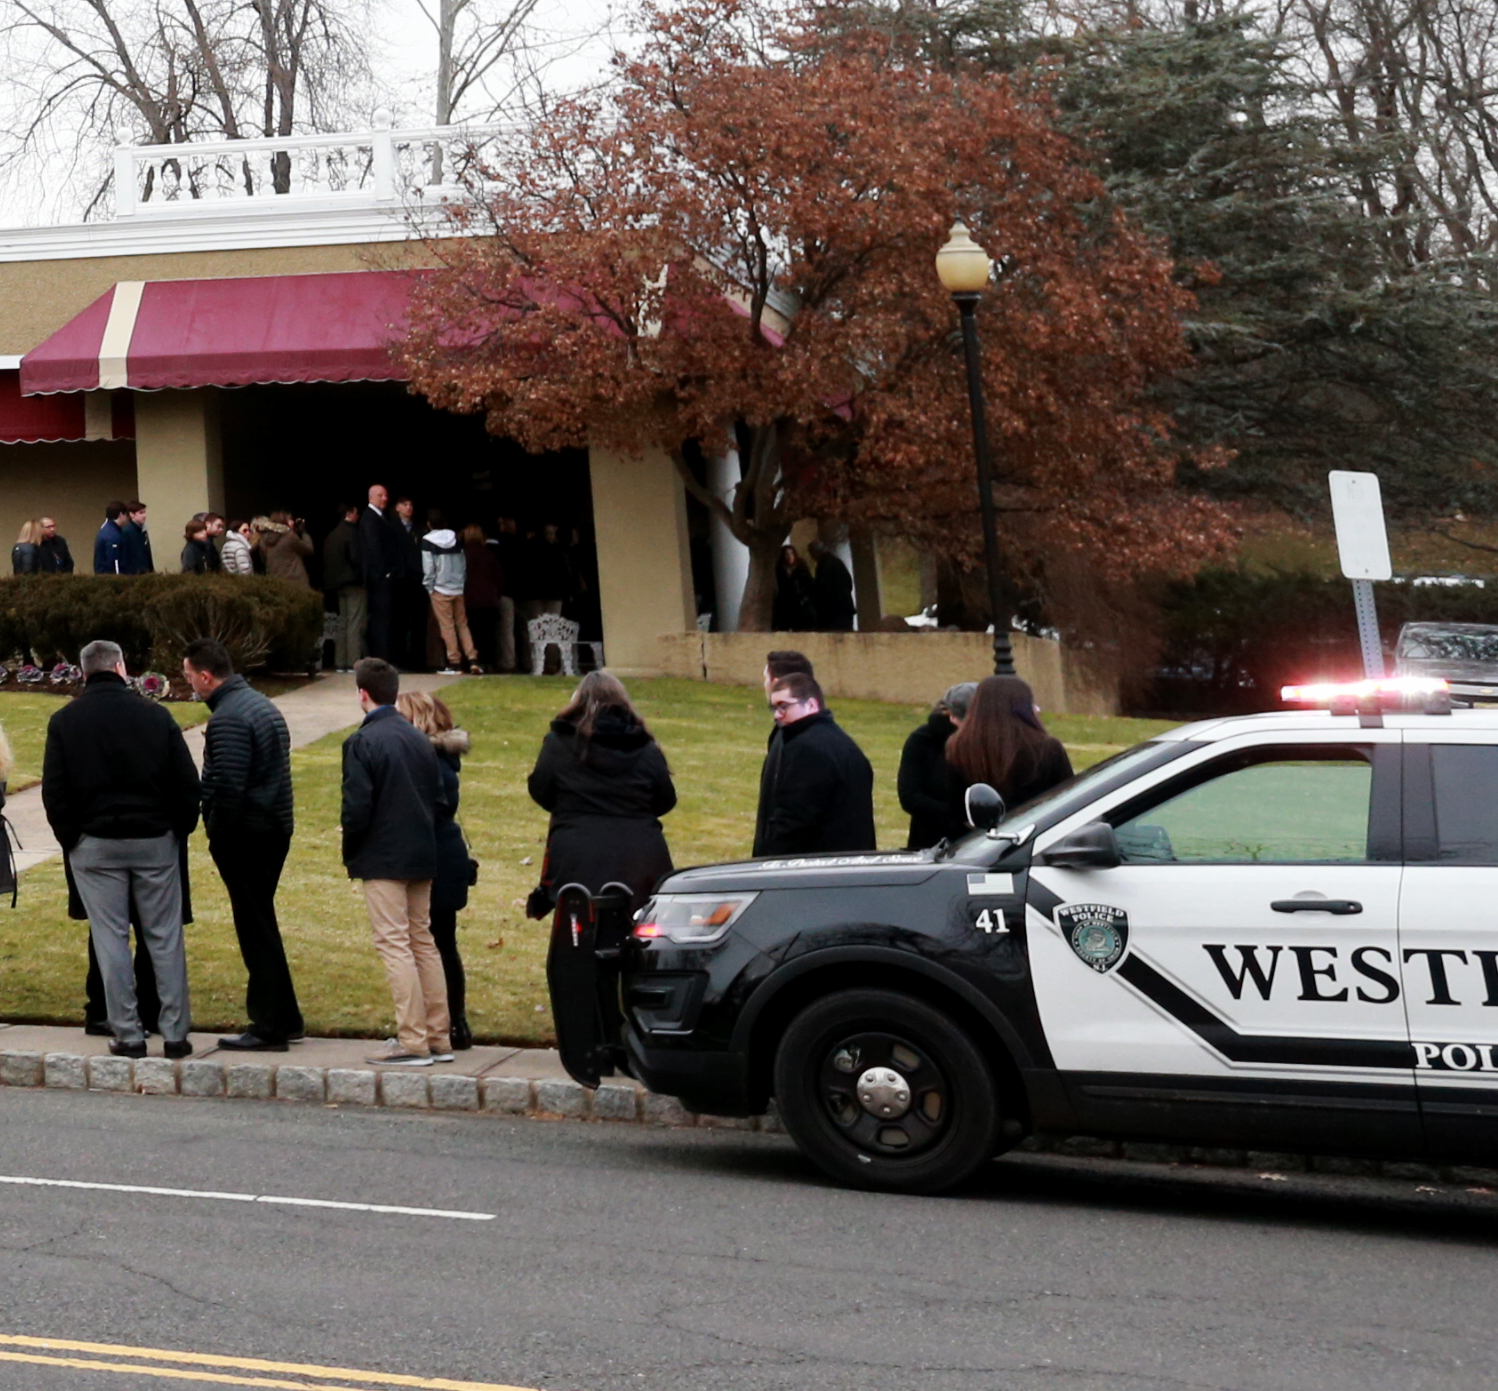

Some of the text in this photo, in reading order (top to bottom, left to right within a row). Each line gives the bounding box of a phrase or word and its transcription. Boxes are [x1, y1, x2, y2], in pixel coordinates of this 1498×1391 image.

[1058, 904, 1125, 918] WESTFIELD
[1071, 911, 1114, 923] POLICE
[975, 908, 1011, 934] 41
